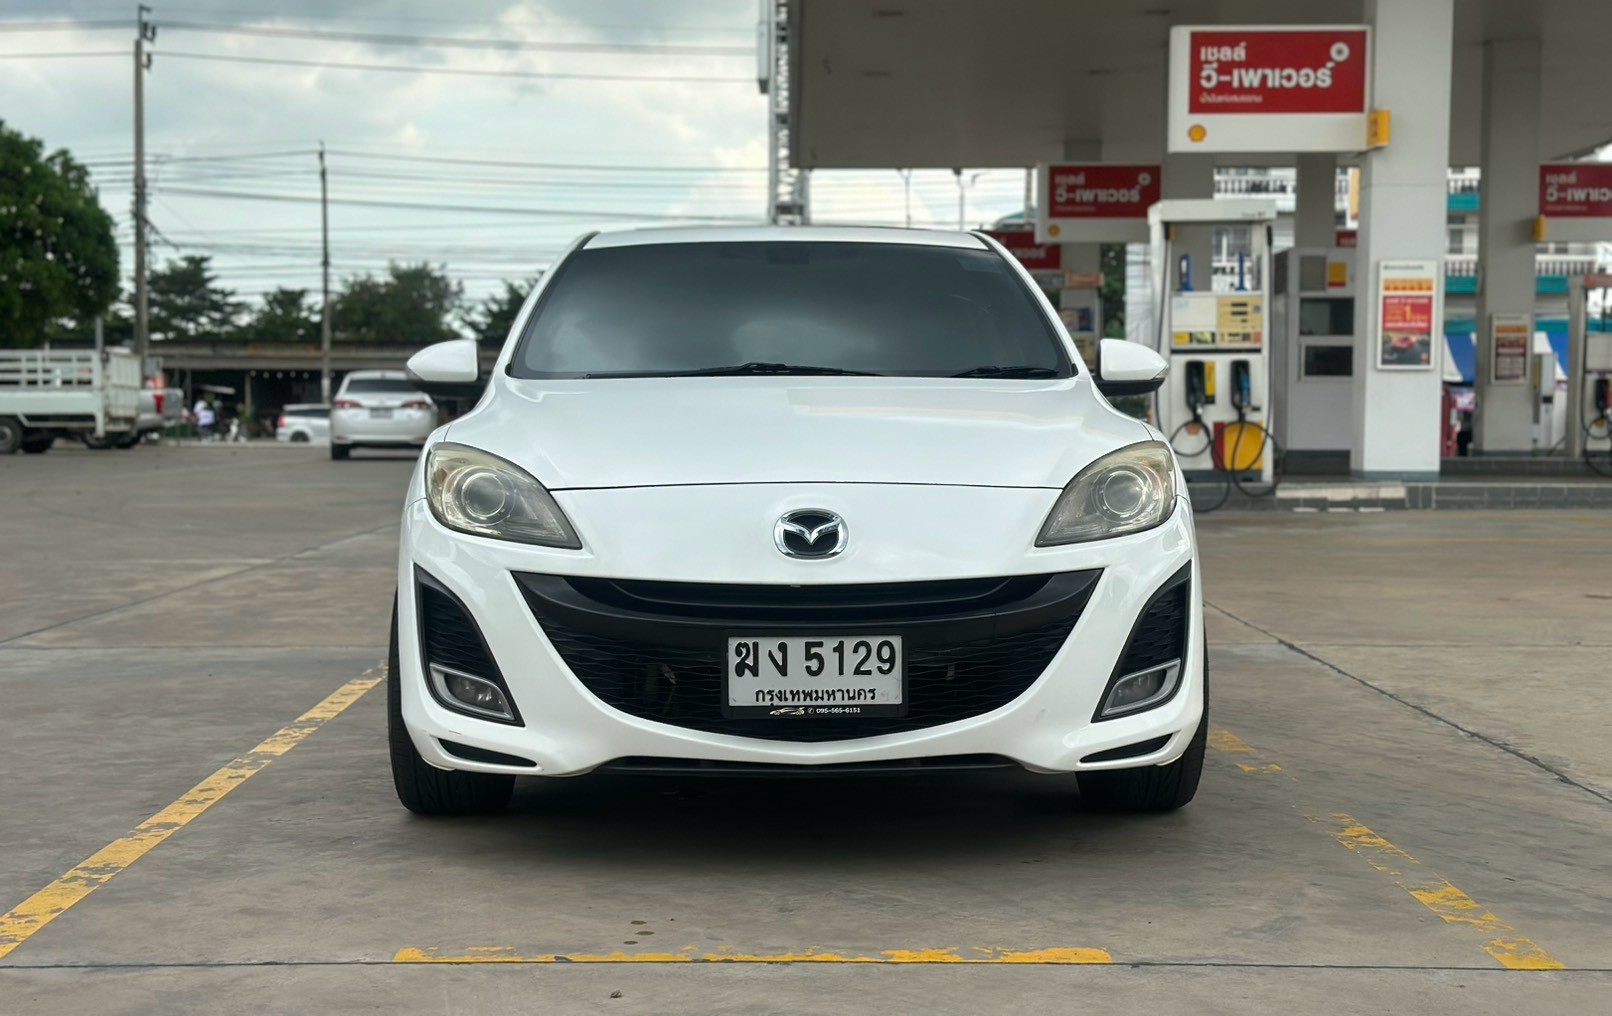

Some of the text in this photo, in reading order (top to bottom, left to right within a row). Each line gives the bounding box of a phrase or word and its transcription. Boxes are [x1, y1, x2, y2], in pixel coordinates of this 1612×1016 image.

[1200, 42, 1247, 62] เชลล์
[1200, 62, 1337, 89] วี-เพาเวอร์
[1546, 186, 1612, 203] วี-เพาเว
[804, 640, 896, 677] 5129
[755, 688, 876, 706] กรุงเทพมหานคร
